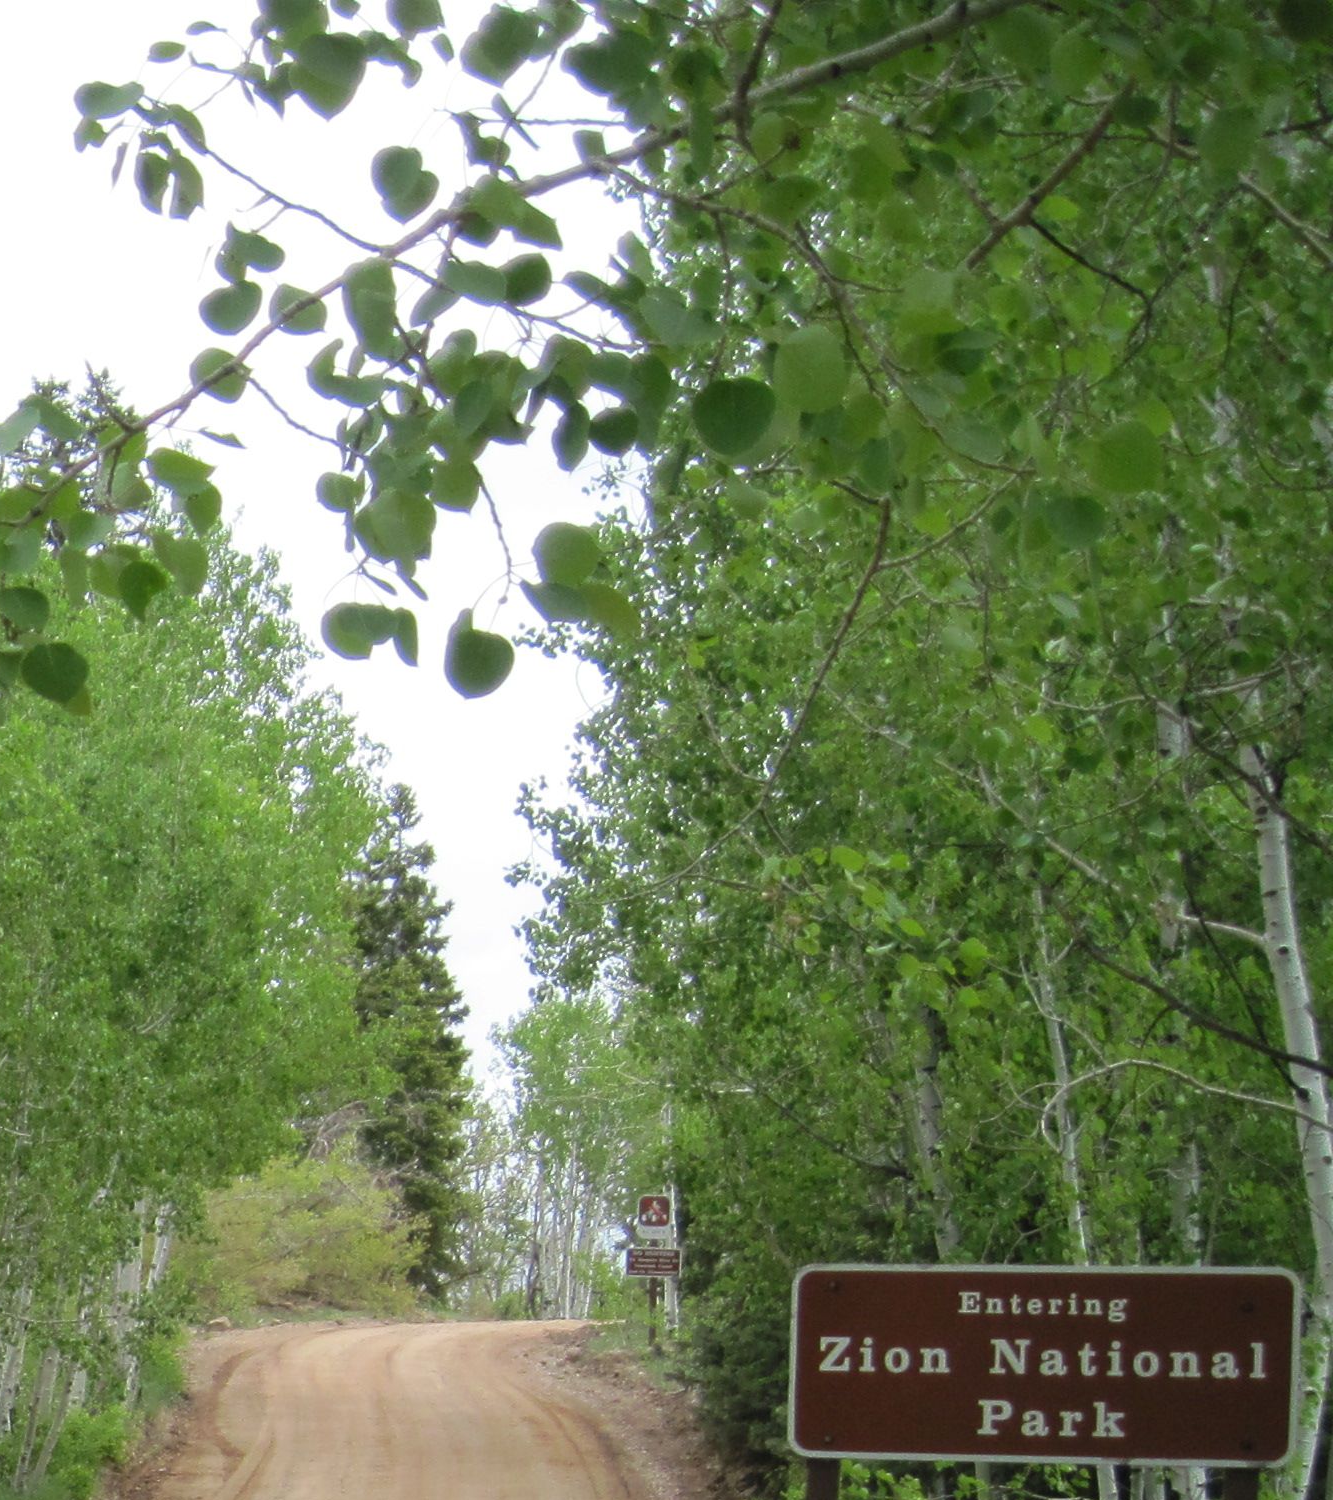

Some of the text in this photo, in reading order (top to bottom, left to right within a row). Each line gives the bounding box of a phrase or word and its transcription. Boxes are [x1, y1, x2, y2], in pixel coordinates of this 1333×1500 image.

[957, 1291, 1129, 1321] Entering
[819, 1336, 1267, 1379] Zion National
[976, 1399, 1127, 1438] Park
